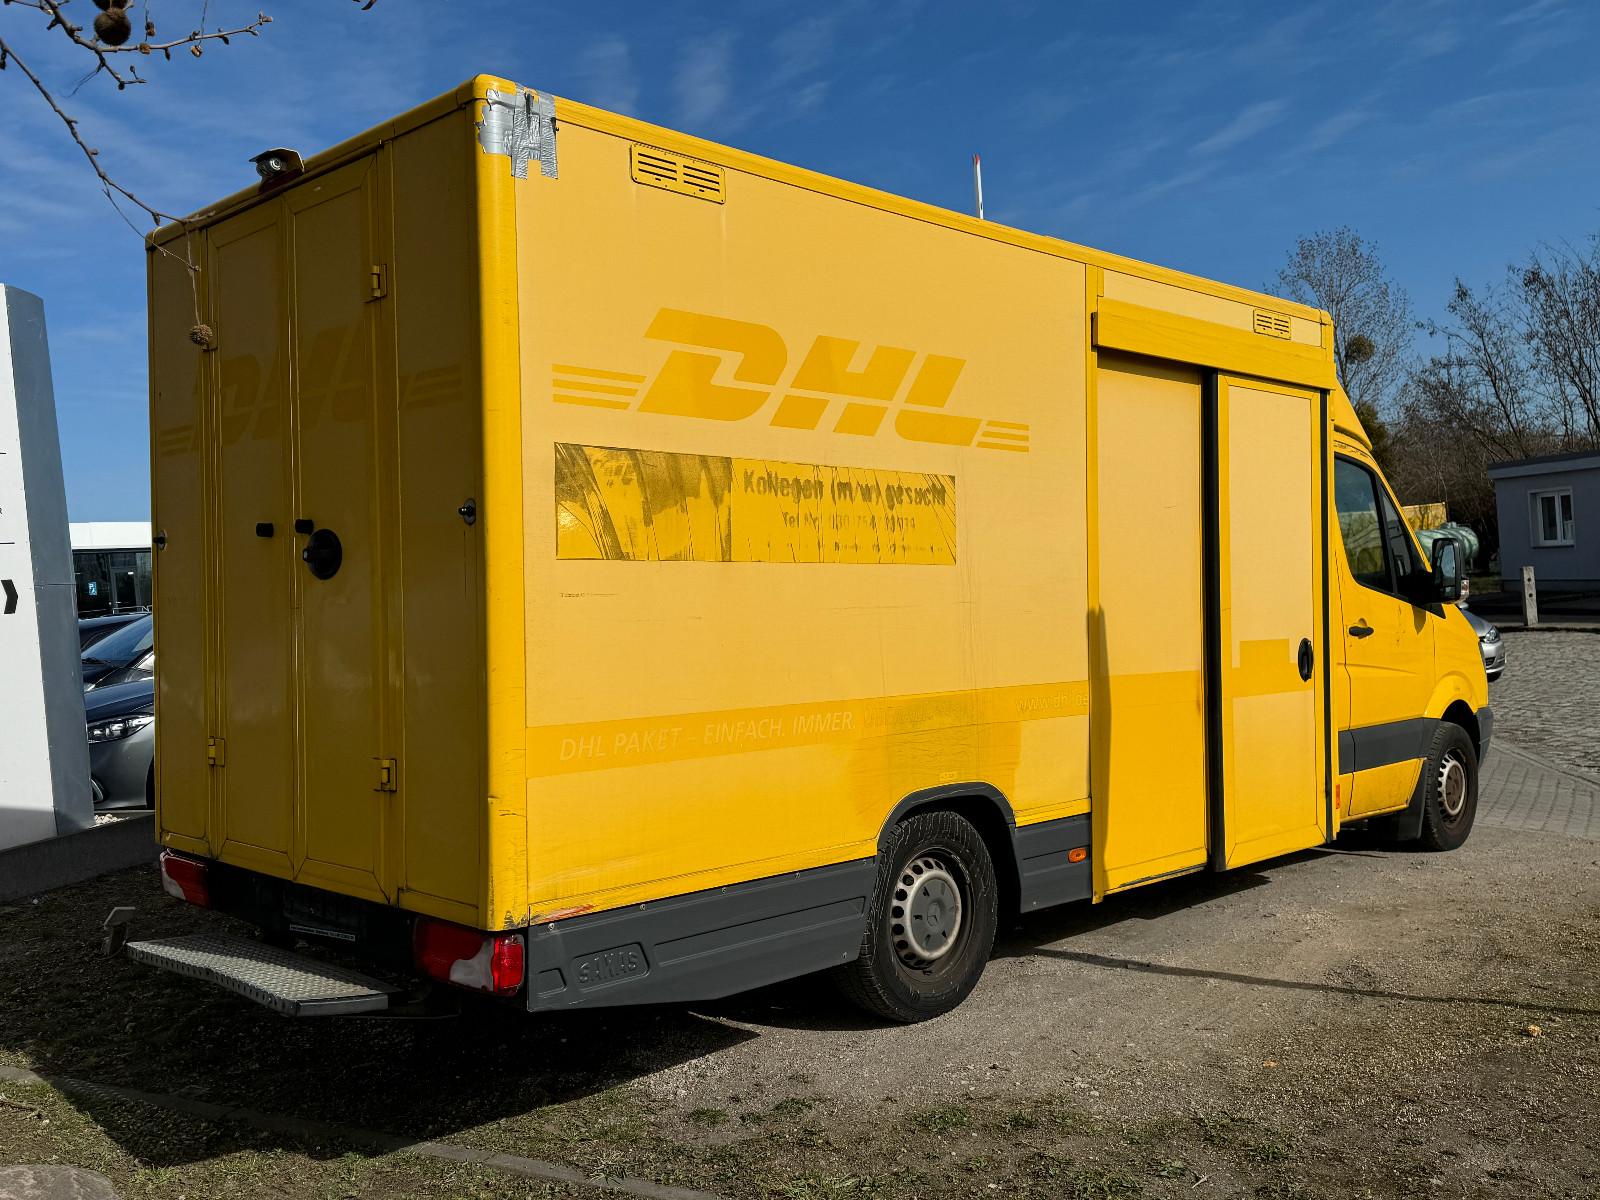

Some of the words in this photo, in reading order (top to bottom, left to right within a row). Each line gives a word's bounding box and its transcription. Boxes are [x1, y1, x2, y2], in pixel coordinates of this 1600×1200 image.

[637, 307, 981, 447] DHL
[744, 468, 823, 504] Kollegen
[559, 735, 606, 761] DHL
[613, 726, 684, 755] PAKET
[703, 717, 785, 745] EINFACH.
[792, 710, 857, 736] IMMER.
